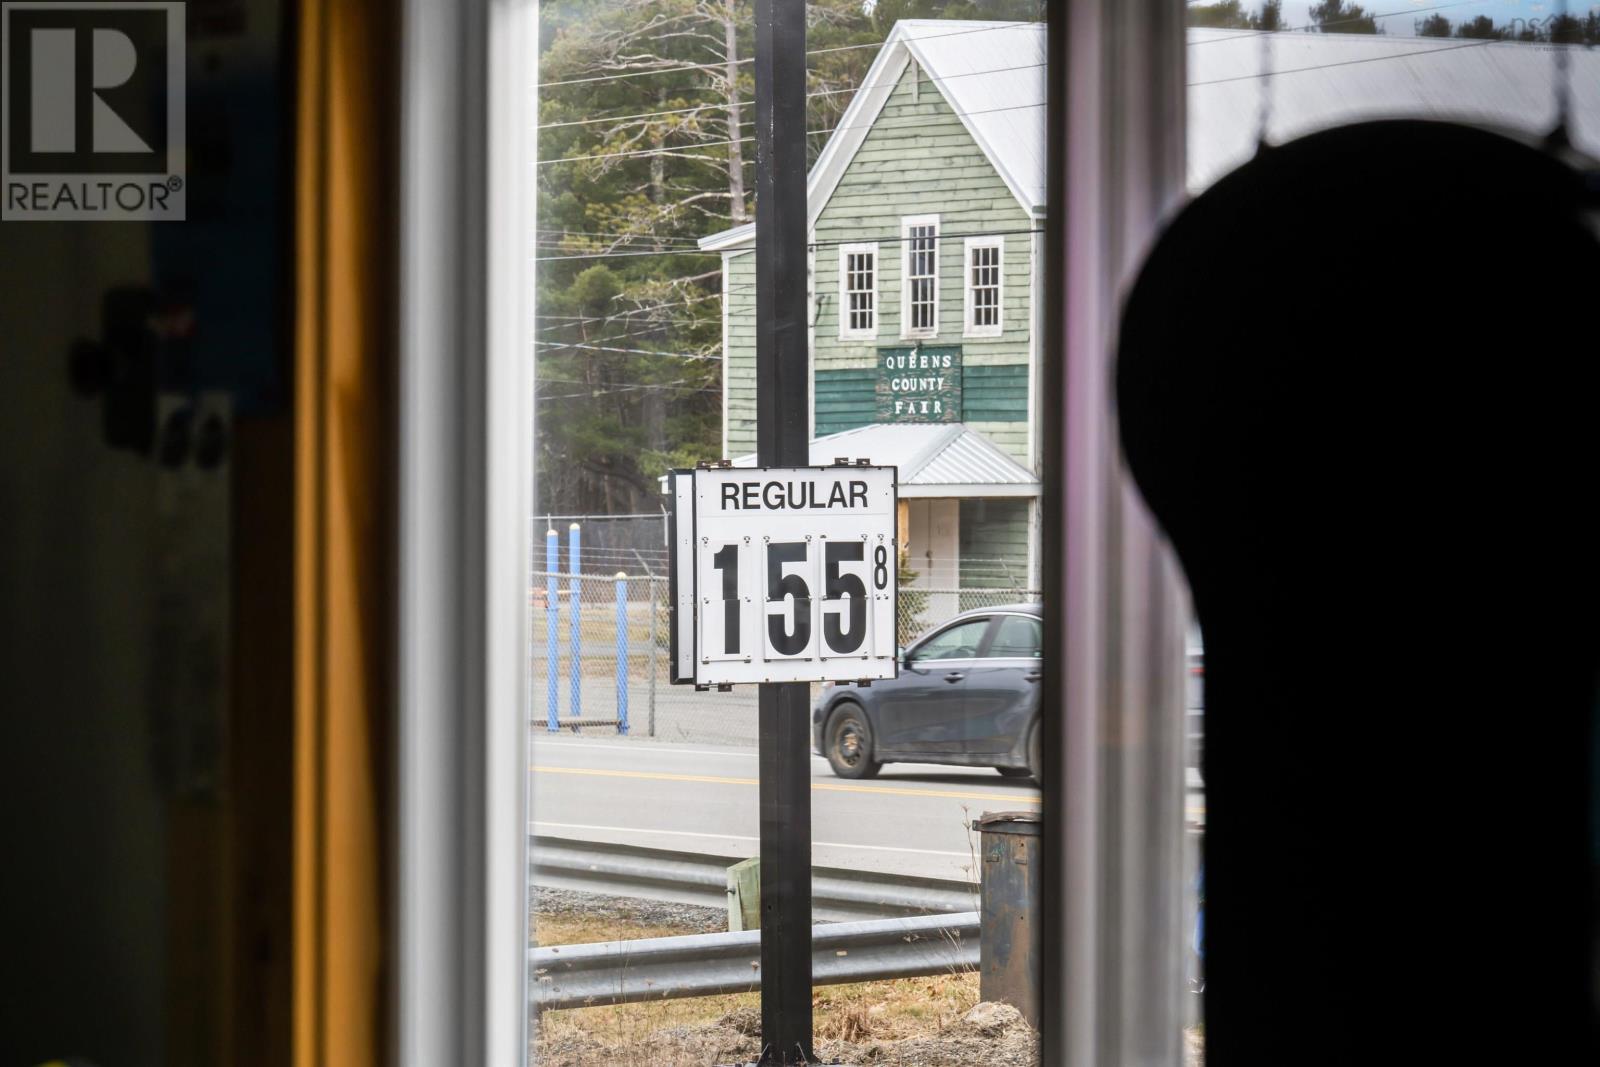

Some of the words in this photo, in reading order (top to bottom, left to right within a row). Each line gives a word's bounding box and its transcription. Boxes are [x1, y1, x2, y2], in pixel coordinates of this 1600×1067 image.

[886, 355, 952, 369] QUEENS
[891, 377, 945, 391] COUNTY
[894, 400, 942, 414] FAIR
[721, 480, 869, 511] REGULAR
